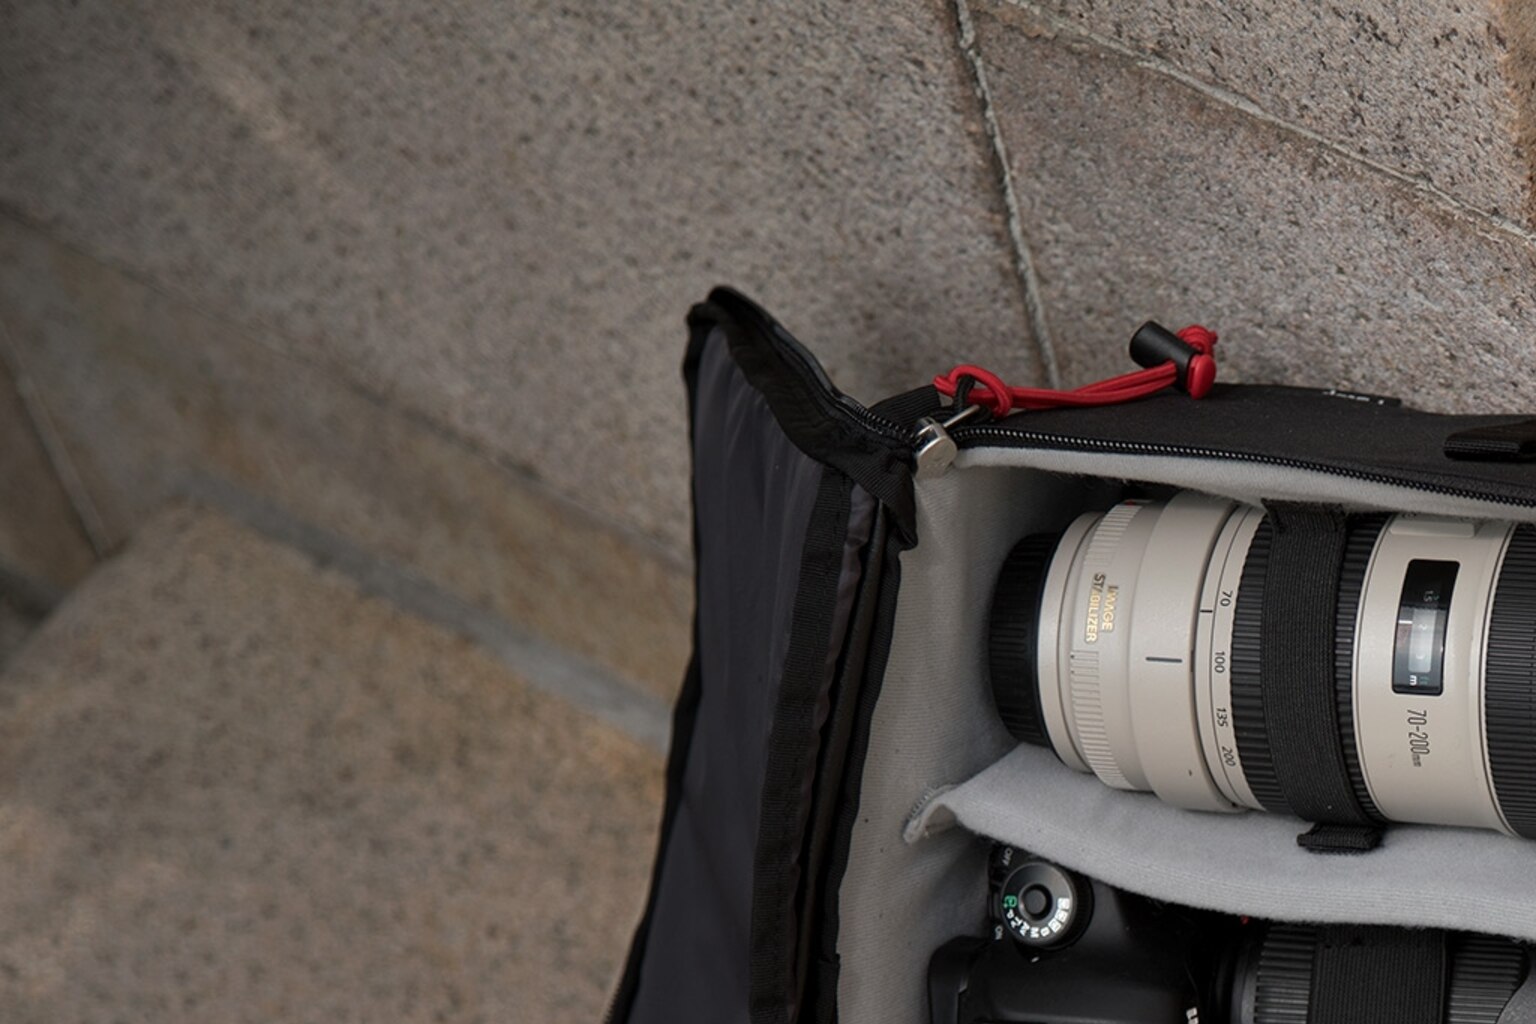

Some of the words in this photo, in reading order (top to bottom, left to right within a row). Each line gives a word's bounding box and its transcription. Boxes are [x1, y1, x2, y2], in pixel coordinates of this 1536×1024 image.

[1101, 585, 1118, 632] IMAGE
[1220, 589, 1233, 607] 70
[1213, 650, 1226, 674] 100
[1215, 706, 1229, 728] 135
[1220, 745, 1237, 768] 200
